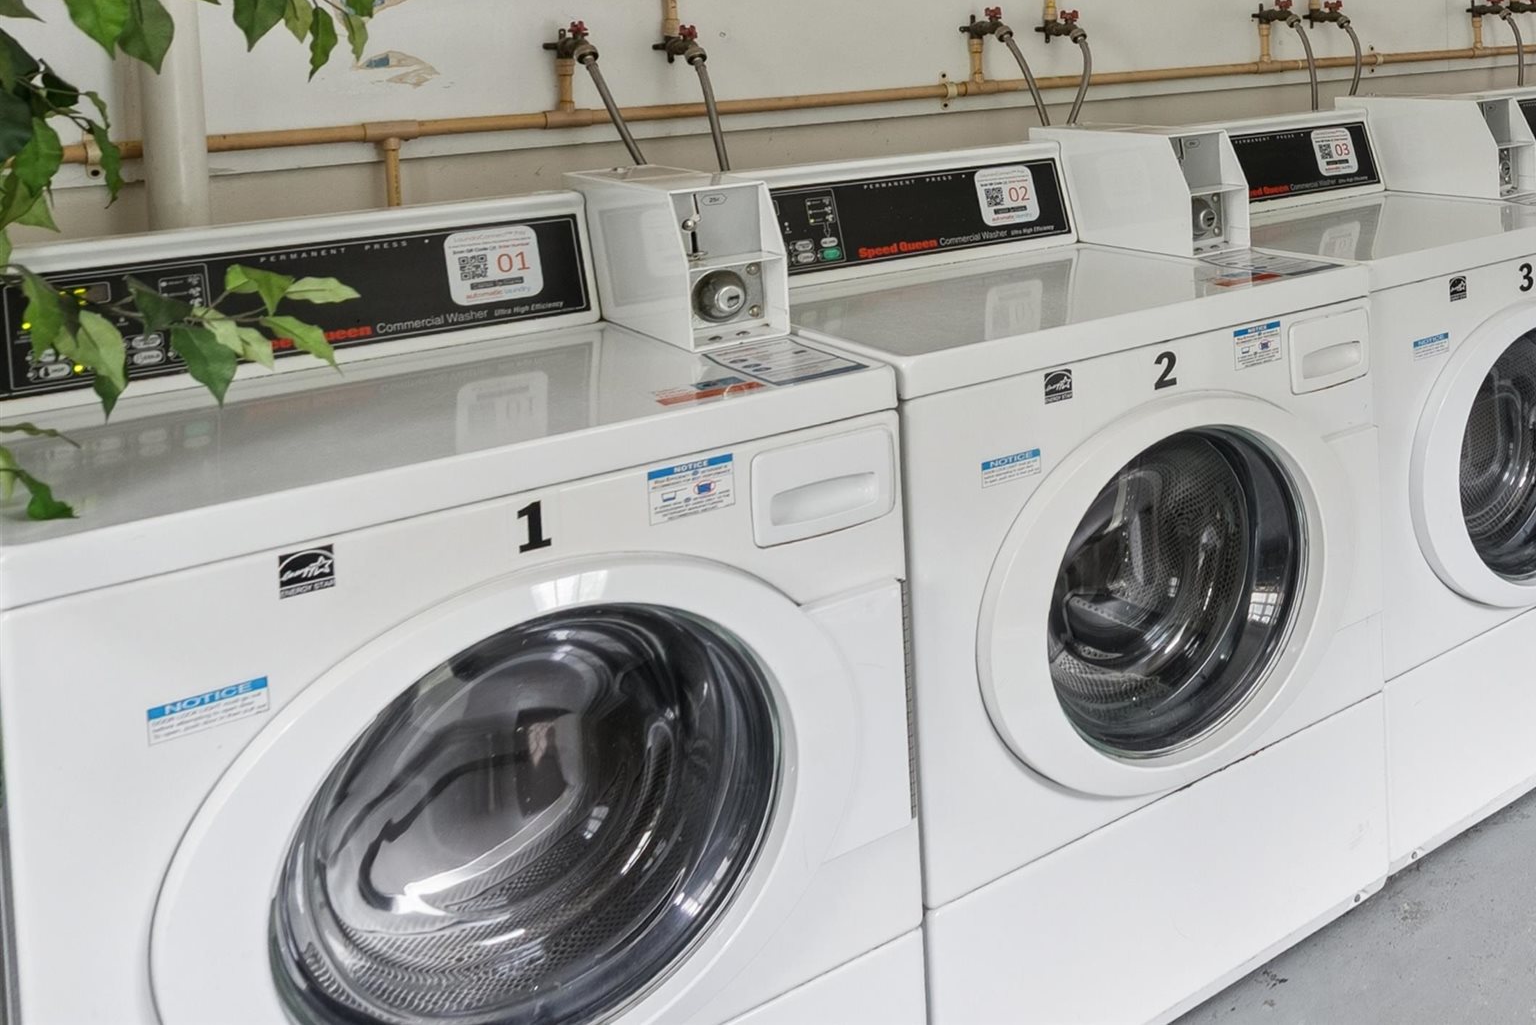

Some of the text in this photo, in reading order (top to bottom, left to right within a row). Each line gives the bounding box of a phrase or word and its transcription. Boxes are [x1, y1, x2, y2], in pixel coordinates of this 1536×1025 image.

[1335, 143, 1350, 157] 03
[864, 175, 953, 190] PERMANENT PRESS
[1008, 186, 1030, 202] 02
[260, 240, 409, 263] PERMANENT PRESS
[858, 230, 1008, 258] Speed Queen Commercial Washer
[496, 251, 531, 273] 01
[1518, 262, 1534, 292] 3
[466, 289, 503, 299] automatic
[494, 300, 564, 316] Ultra High Efficiency
[323, 310, 489, 341] ueen Commercial Washer
[1154, 351, 1177, 391] 2
[673, 460, 709, 473] NOTICE
[990, 452, 1032, 468] NOTICE
[517, 500, 552, 554] 1
[280, 578, 336, 599] ENERGY STAR
[163, 680, 253, 715] NOTICE
